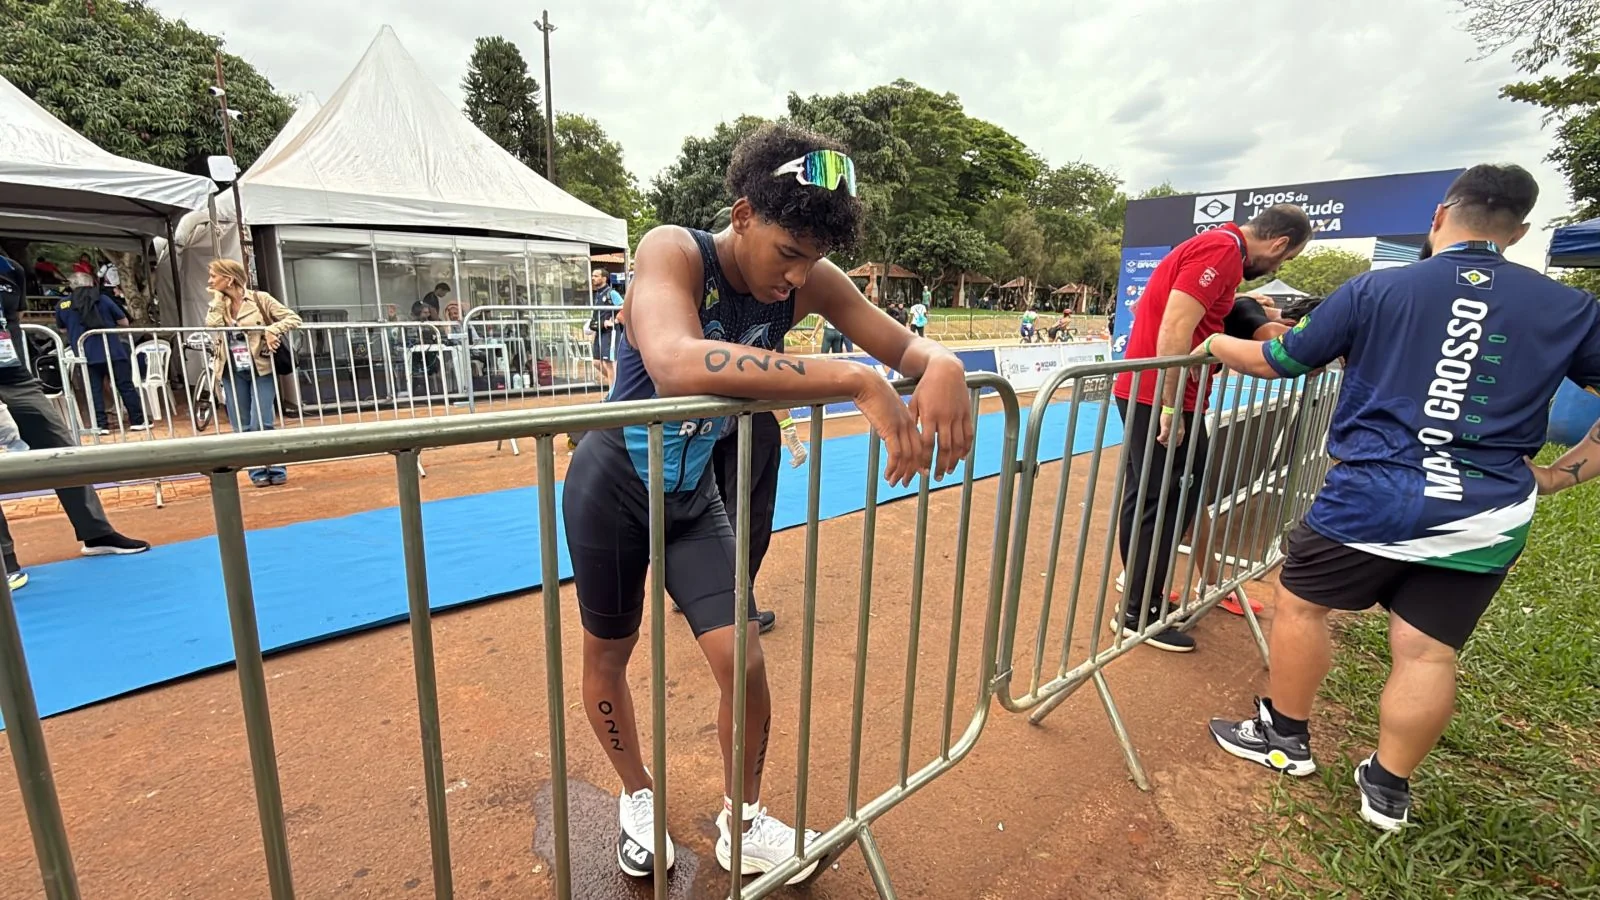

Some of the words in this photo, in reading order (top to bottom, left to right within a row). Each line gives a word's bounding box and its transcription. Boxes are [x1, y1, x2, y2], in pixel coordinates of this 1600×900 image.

[1243, 191, 1295, 207] Jogos
[1295, 192, 1309, 202] da
[1248, 199, 1344, 221] Jtude
[704, 349, 806, 376] 022
[1424, 298, 1488, 421] GROSSO
[598, 700, 625, 752] 022
[622, 838, 649, 865] FILA
